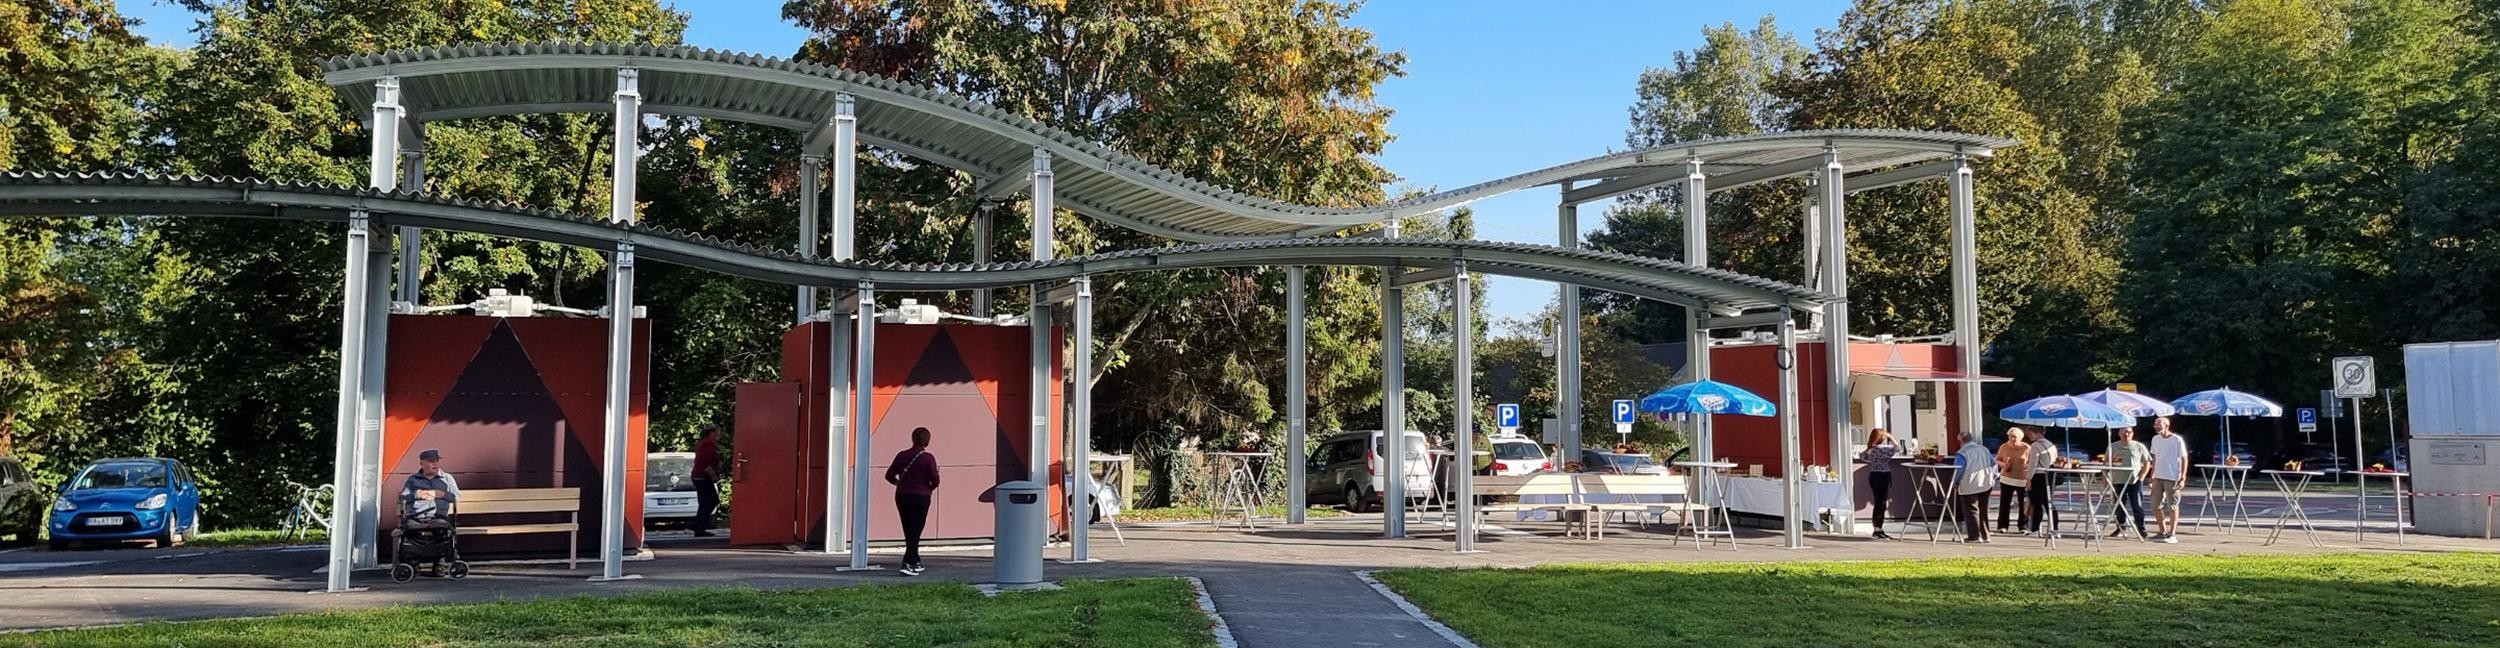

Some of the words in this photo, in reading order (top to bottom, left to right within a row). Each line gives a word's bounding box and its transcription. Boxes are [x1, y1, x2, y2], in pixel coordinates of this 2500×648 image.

[2346, 368, 2360, 379] 30
[1502, 407, 1514, 426] P
[1618, 403, 1630, 421] P
[2301, 410, 2311, 422] P
